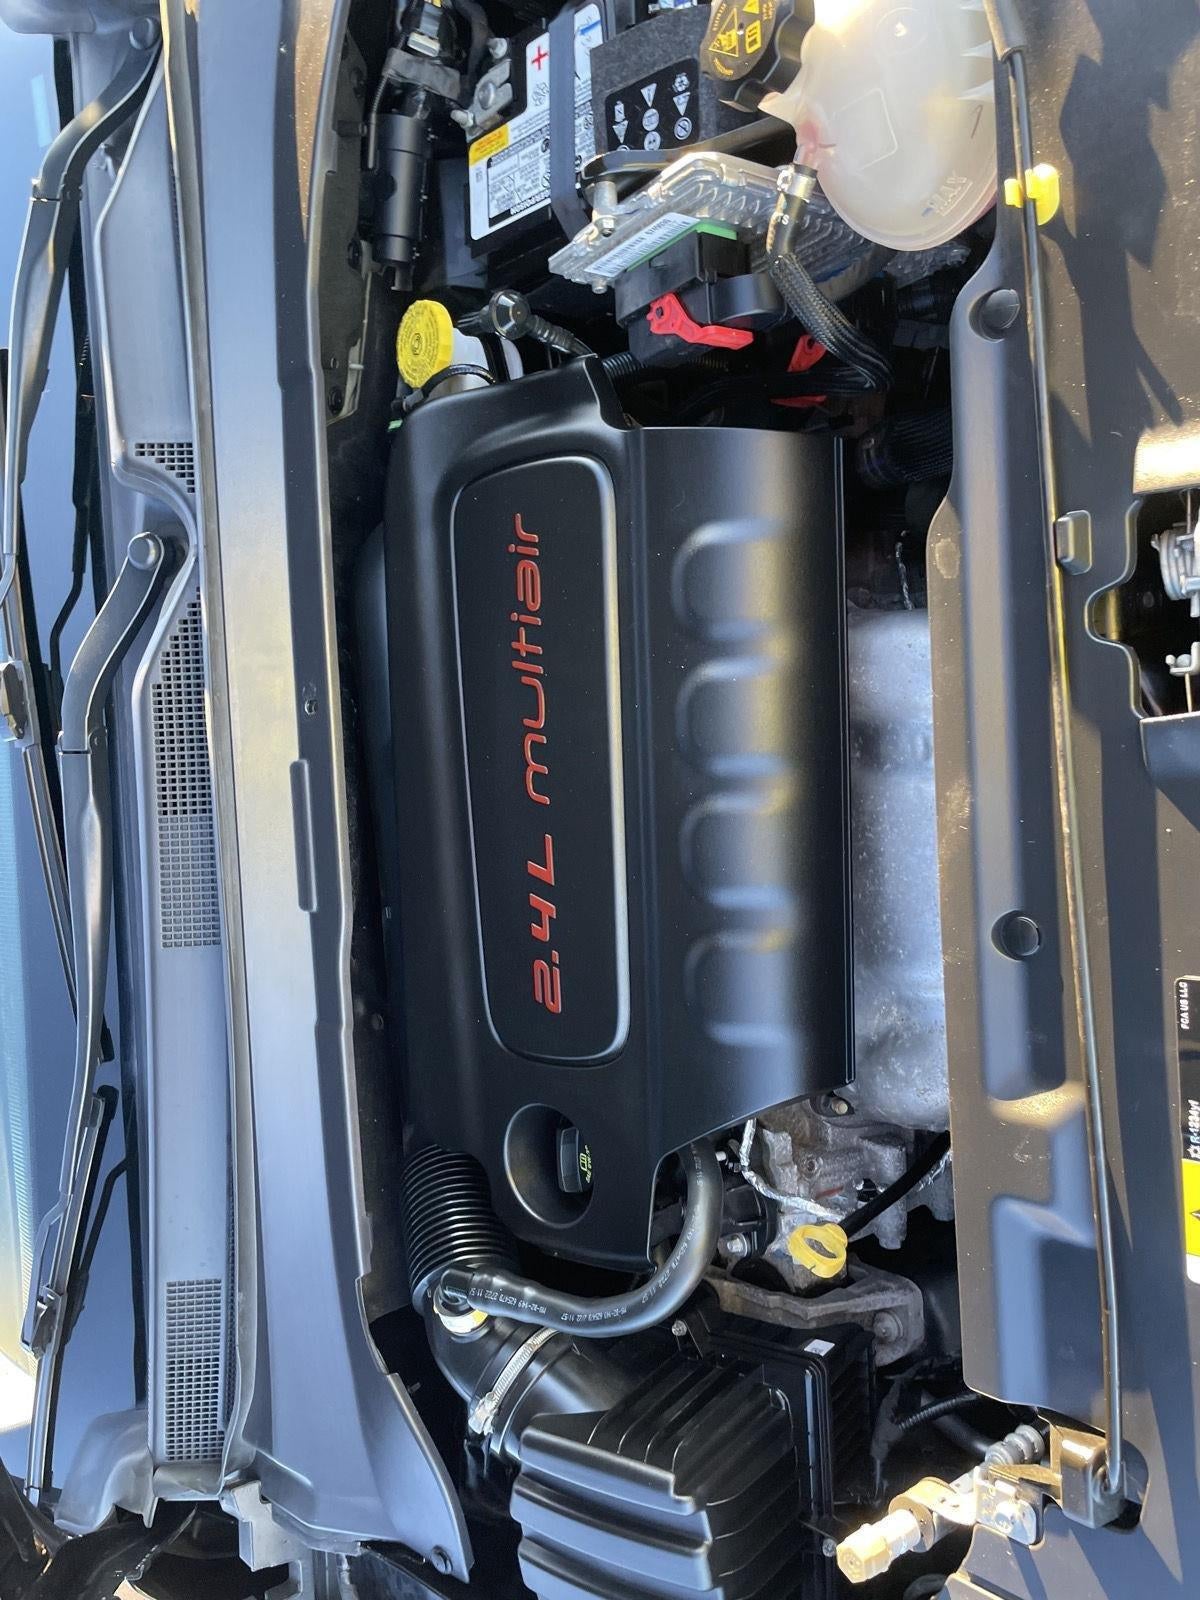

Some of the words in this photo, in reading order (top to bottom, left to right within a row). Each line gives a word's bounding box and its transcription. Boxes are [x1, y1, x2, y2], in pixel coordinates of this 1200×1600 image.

[508, 512, 550, 805] multiair
[527, 833, 562, 1014] 2.4L
[1178, 981, 1188, 998] LLC
[1179, 999, 1189, 1011] US
[1180, 1012, 1190, 1030] FCA
